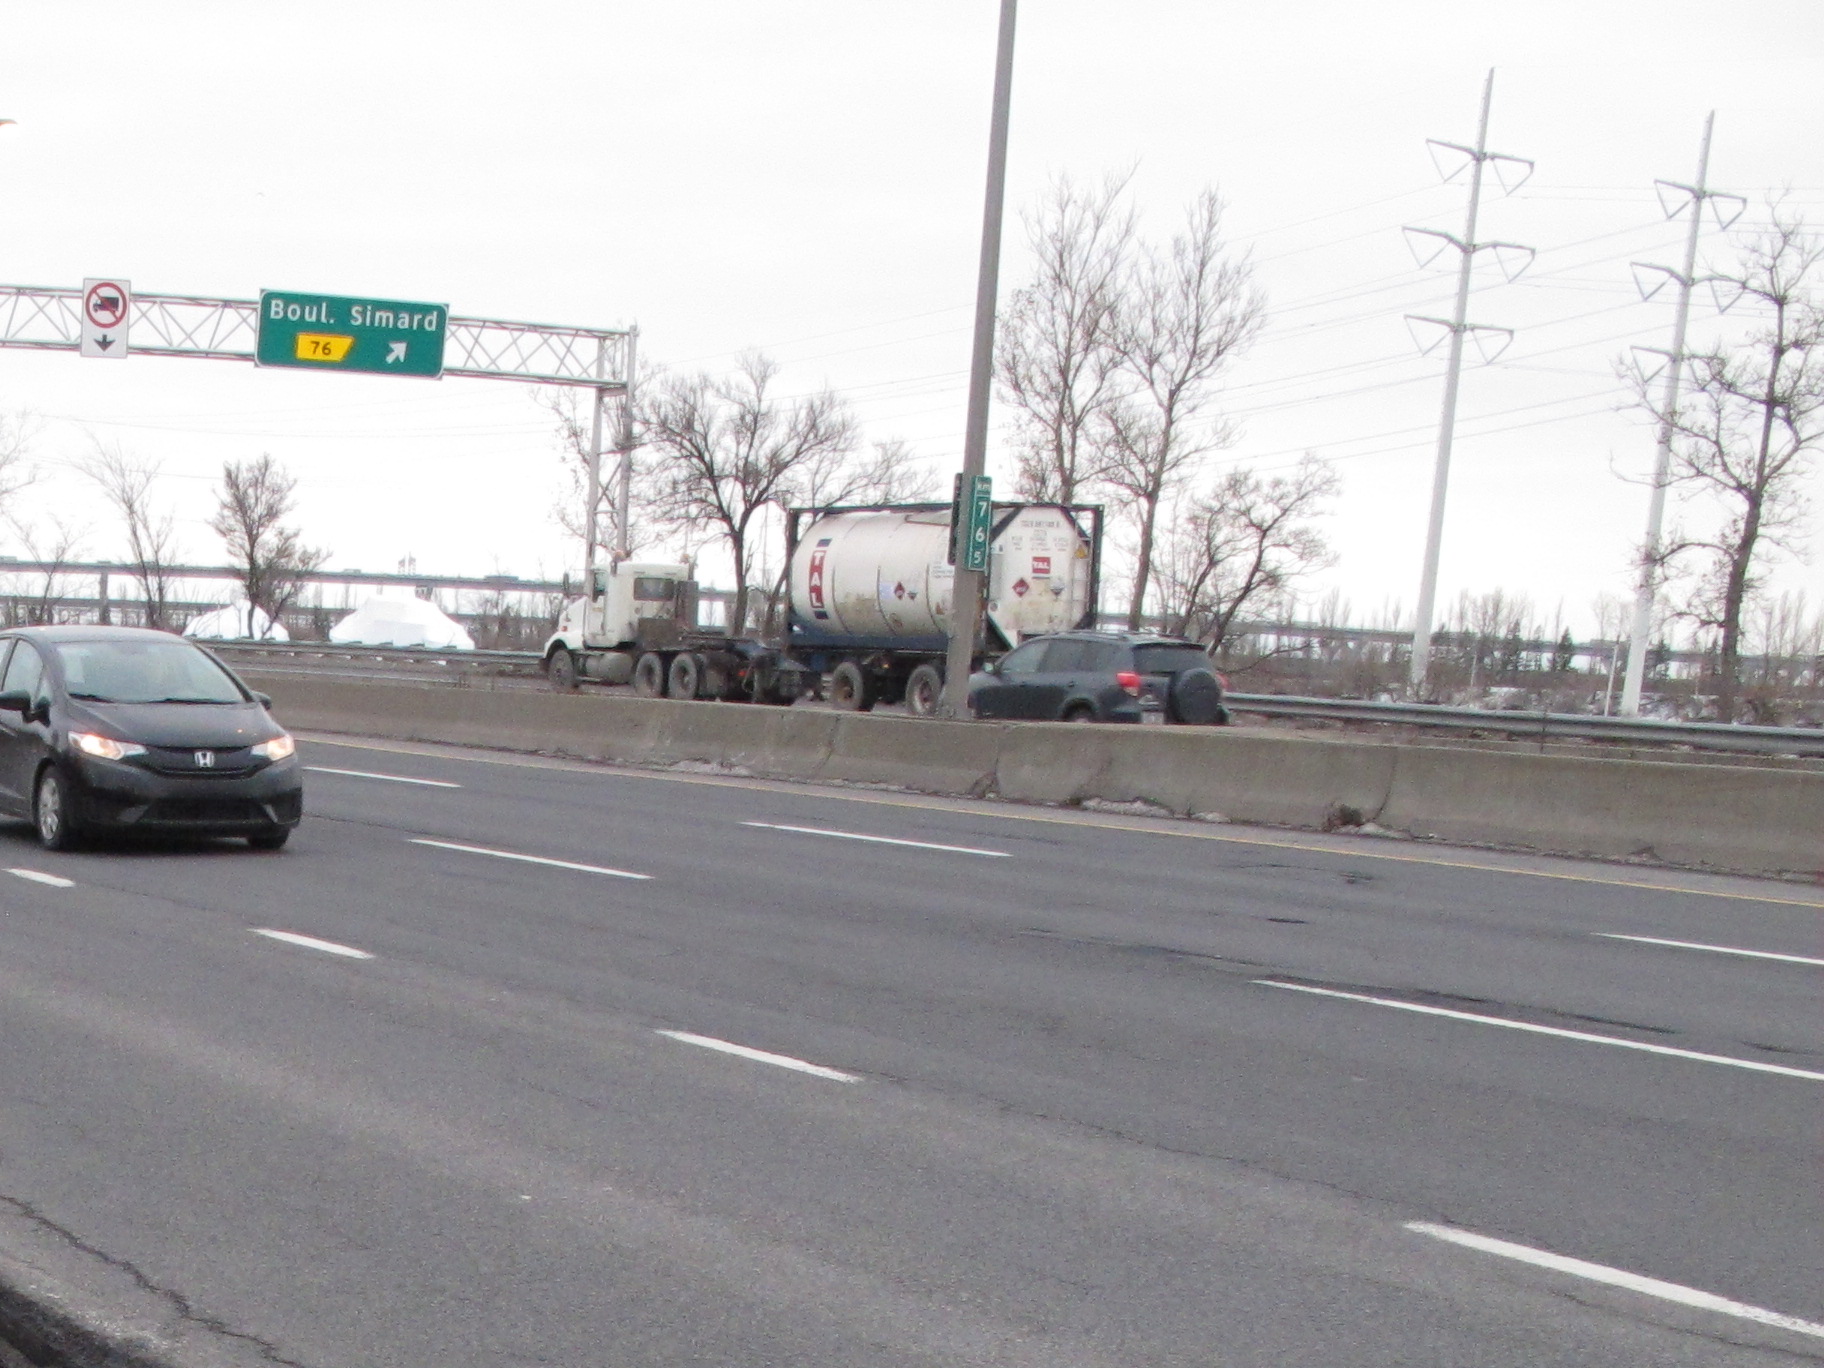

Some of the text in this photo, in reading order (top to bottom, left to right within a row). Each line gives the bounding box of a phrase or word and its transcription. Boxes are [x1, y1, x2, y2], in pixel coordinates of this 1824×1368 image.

[269, 299, 438, 332] Boul. Simard
[310, 340, 332, 356] 76
[809, 551, 825, 608] TAL
